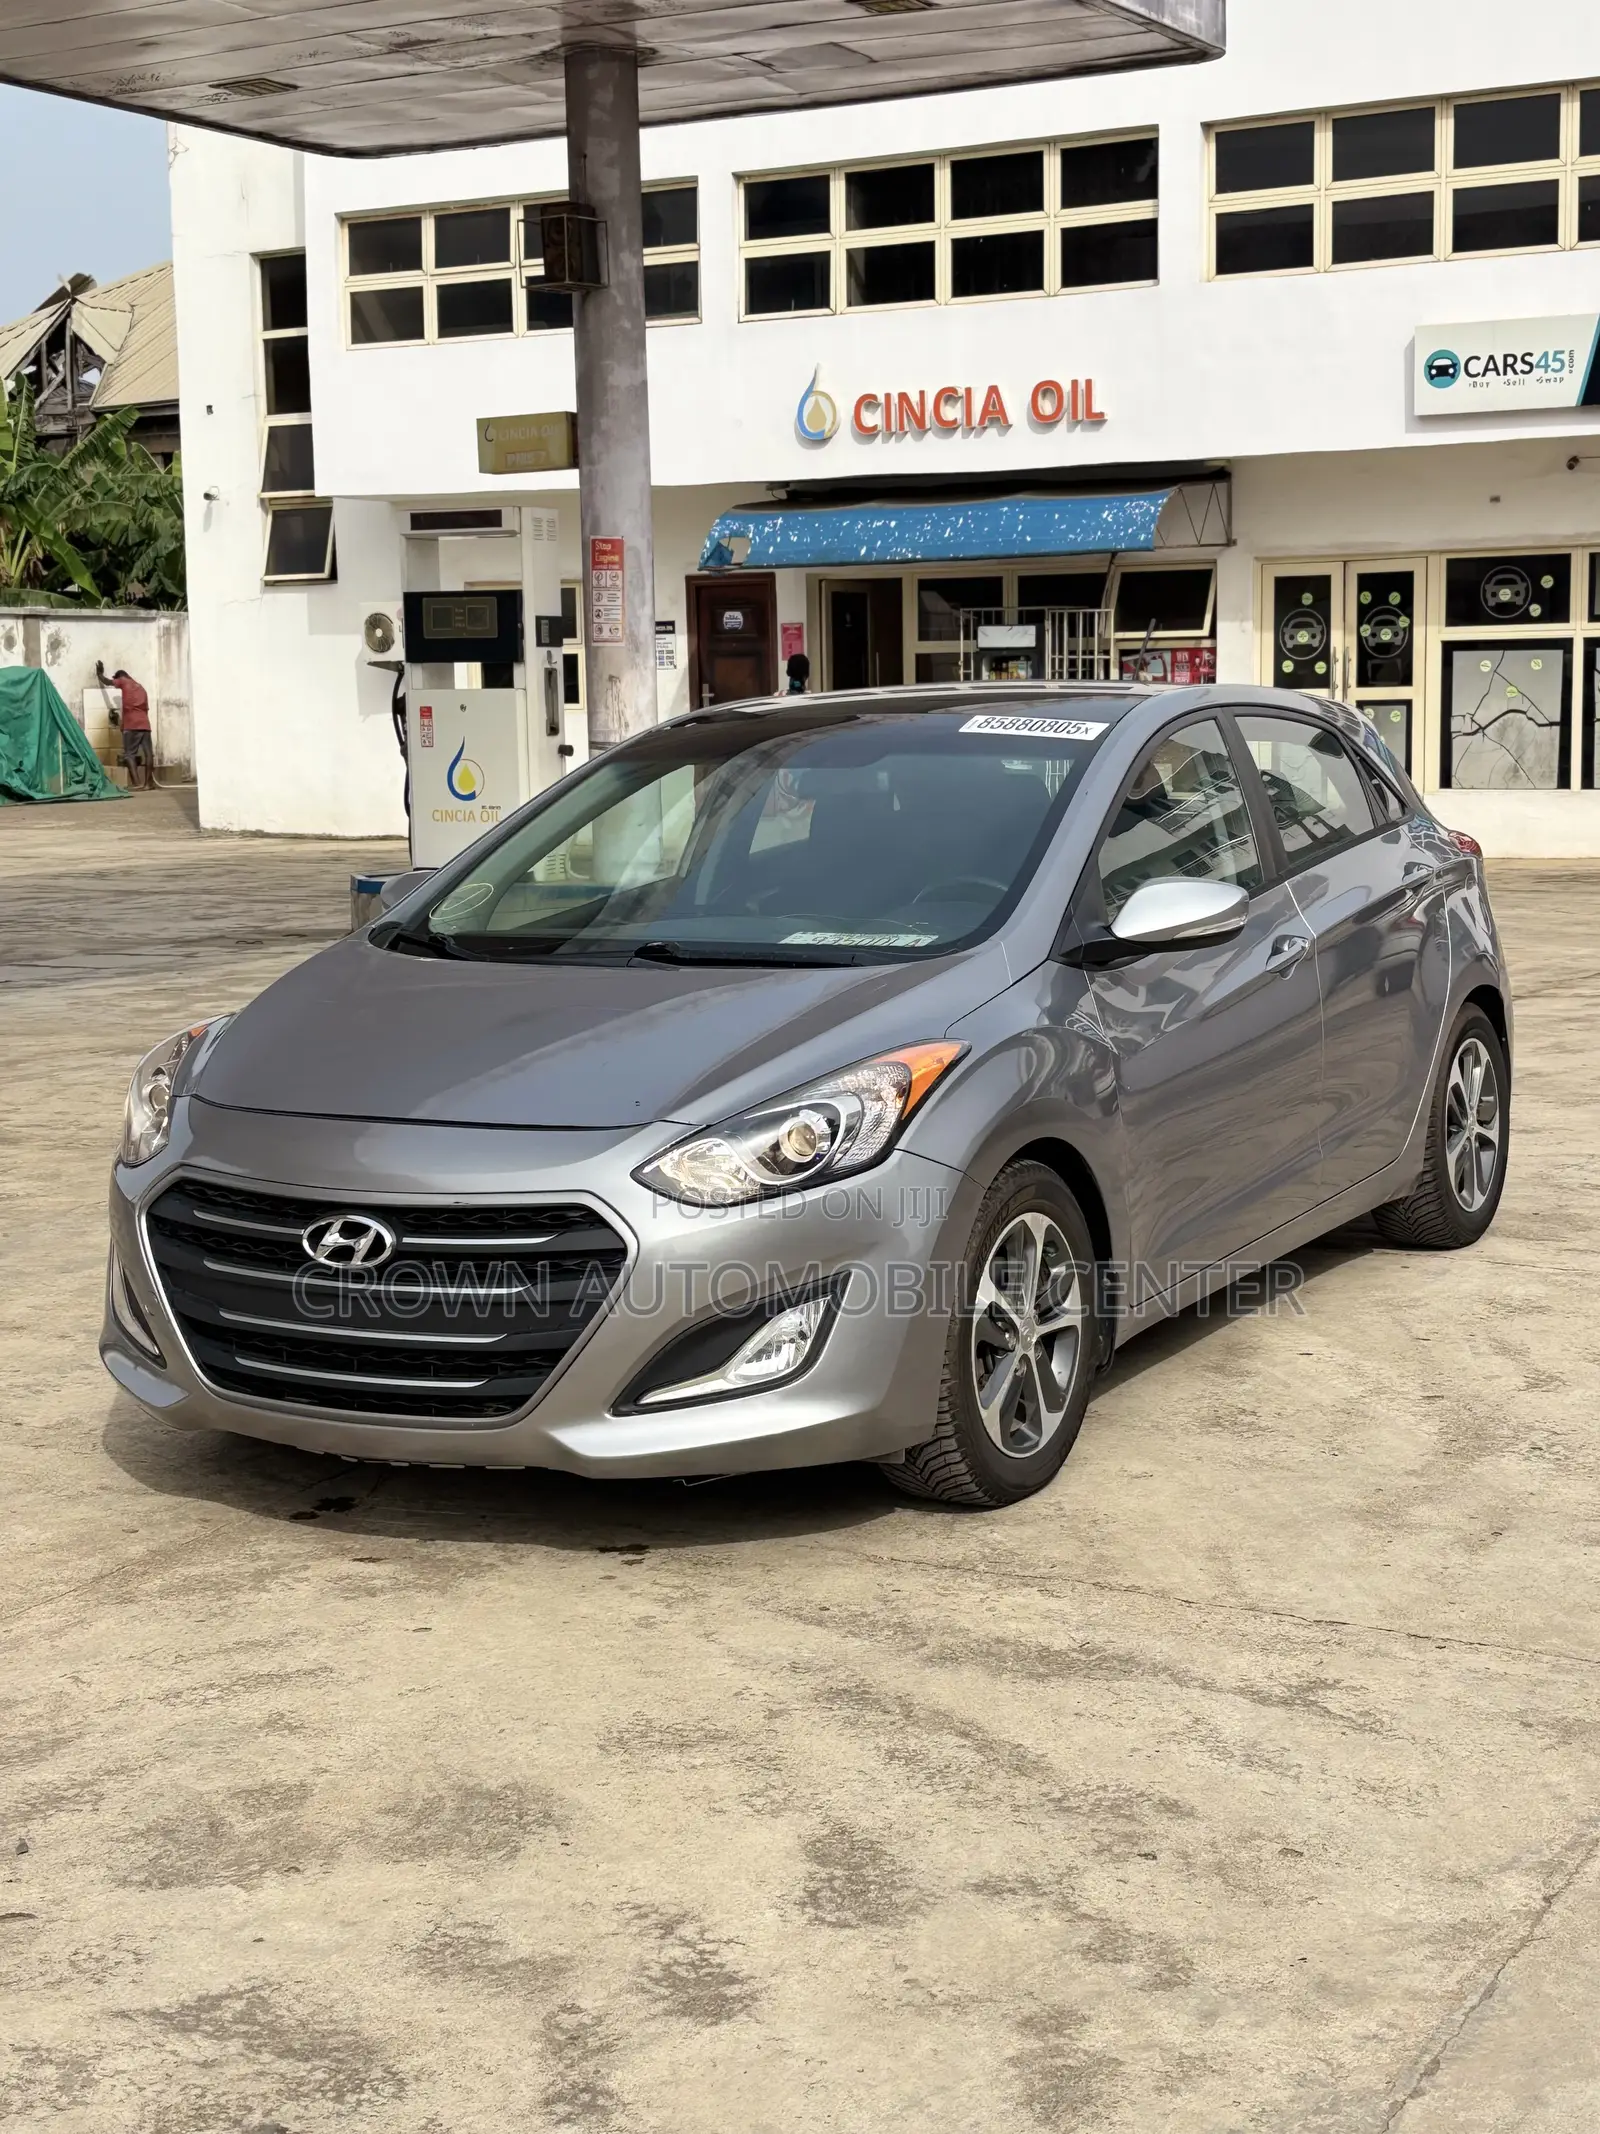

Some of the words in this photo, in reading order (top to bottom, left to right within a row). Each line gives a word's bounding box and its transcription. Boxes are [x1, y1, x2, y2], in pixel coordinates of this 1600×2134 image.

[1464, 350, 1566, 378] CARS45
[853, 384, 1010, 435] CINCIA
[1030, 378, 1107, 424] OIL
[595, 541, 612, 551] Stop
[432, 809, 476, 823] CINCIA
[480, 810, 502, 823] OIL
